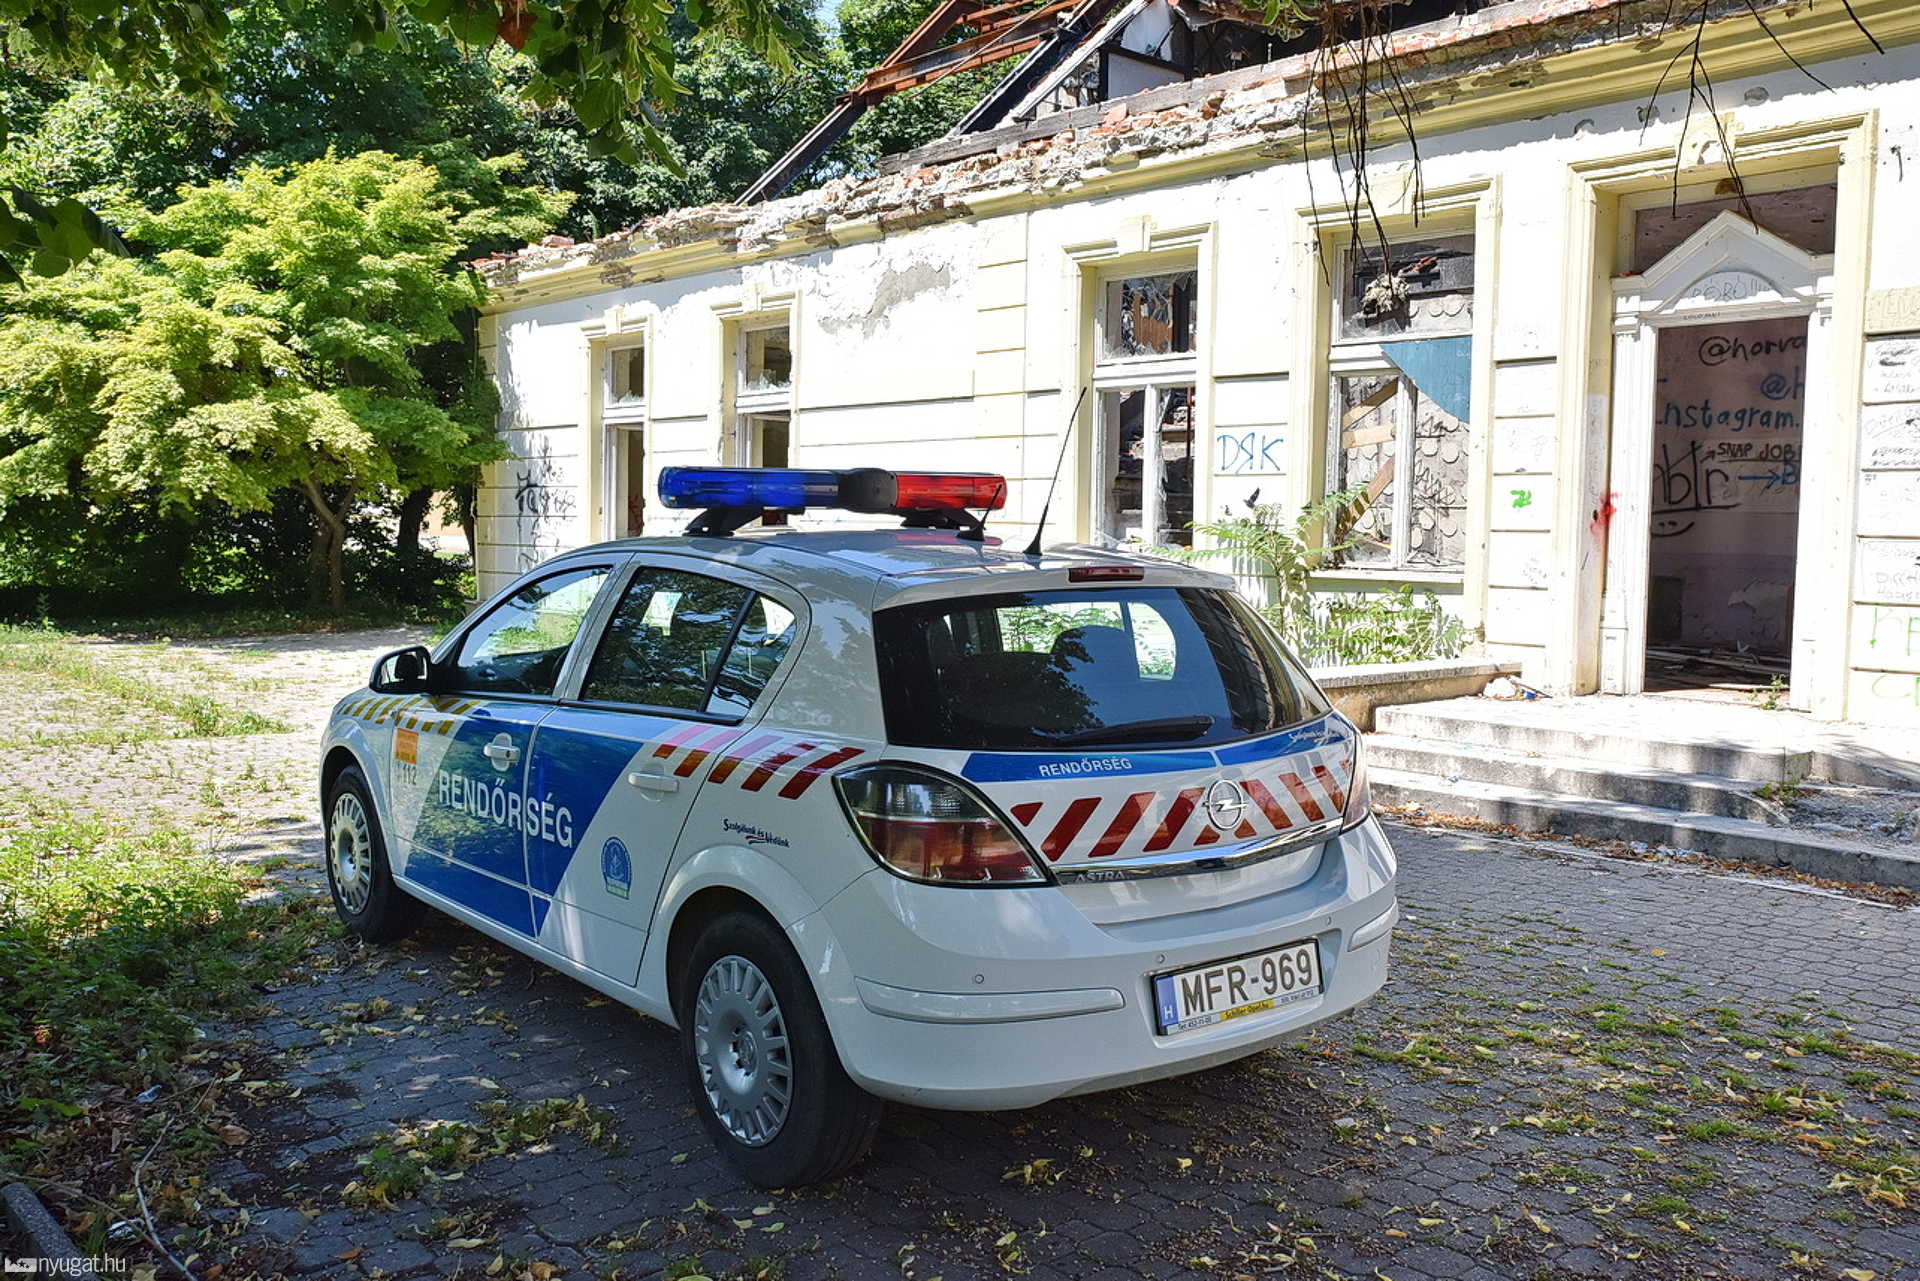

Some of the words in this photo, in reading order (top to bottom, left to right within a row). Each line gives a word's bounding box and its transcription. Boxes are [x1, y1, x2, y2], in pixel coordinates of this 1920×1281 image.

[1656, 388, 1800, 431] nstagram.
[1039, 756, 1133, 778] RENDŐRSÉG
[438, 769, 574, 849] RENDŐRSÉG
[1181, 948, 1313, 1017] MFR-969
